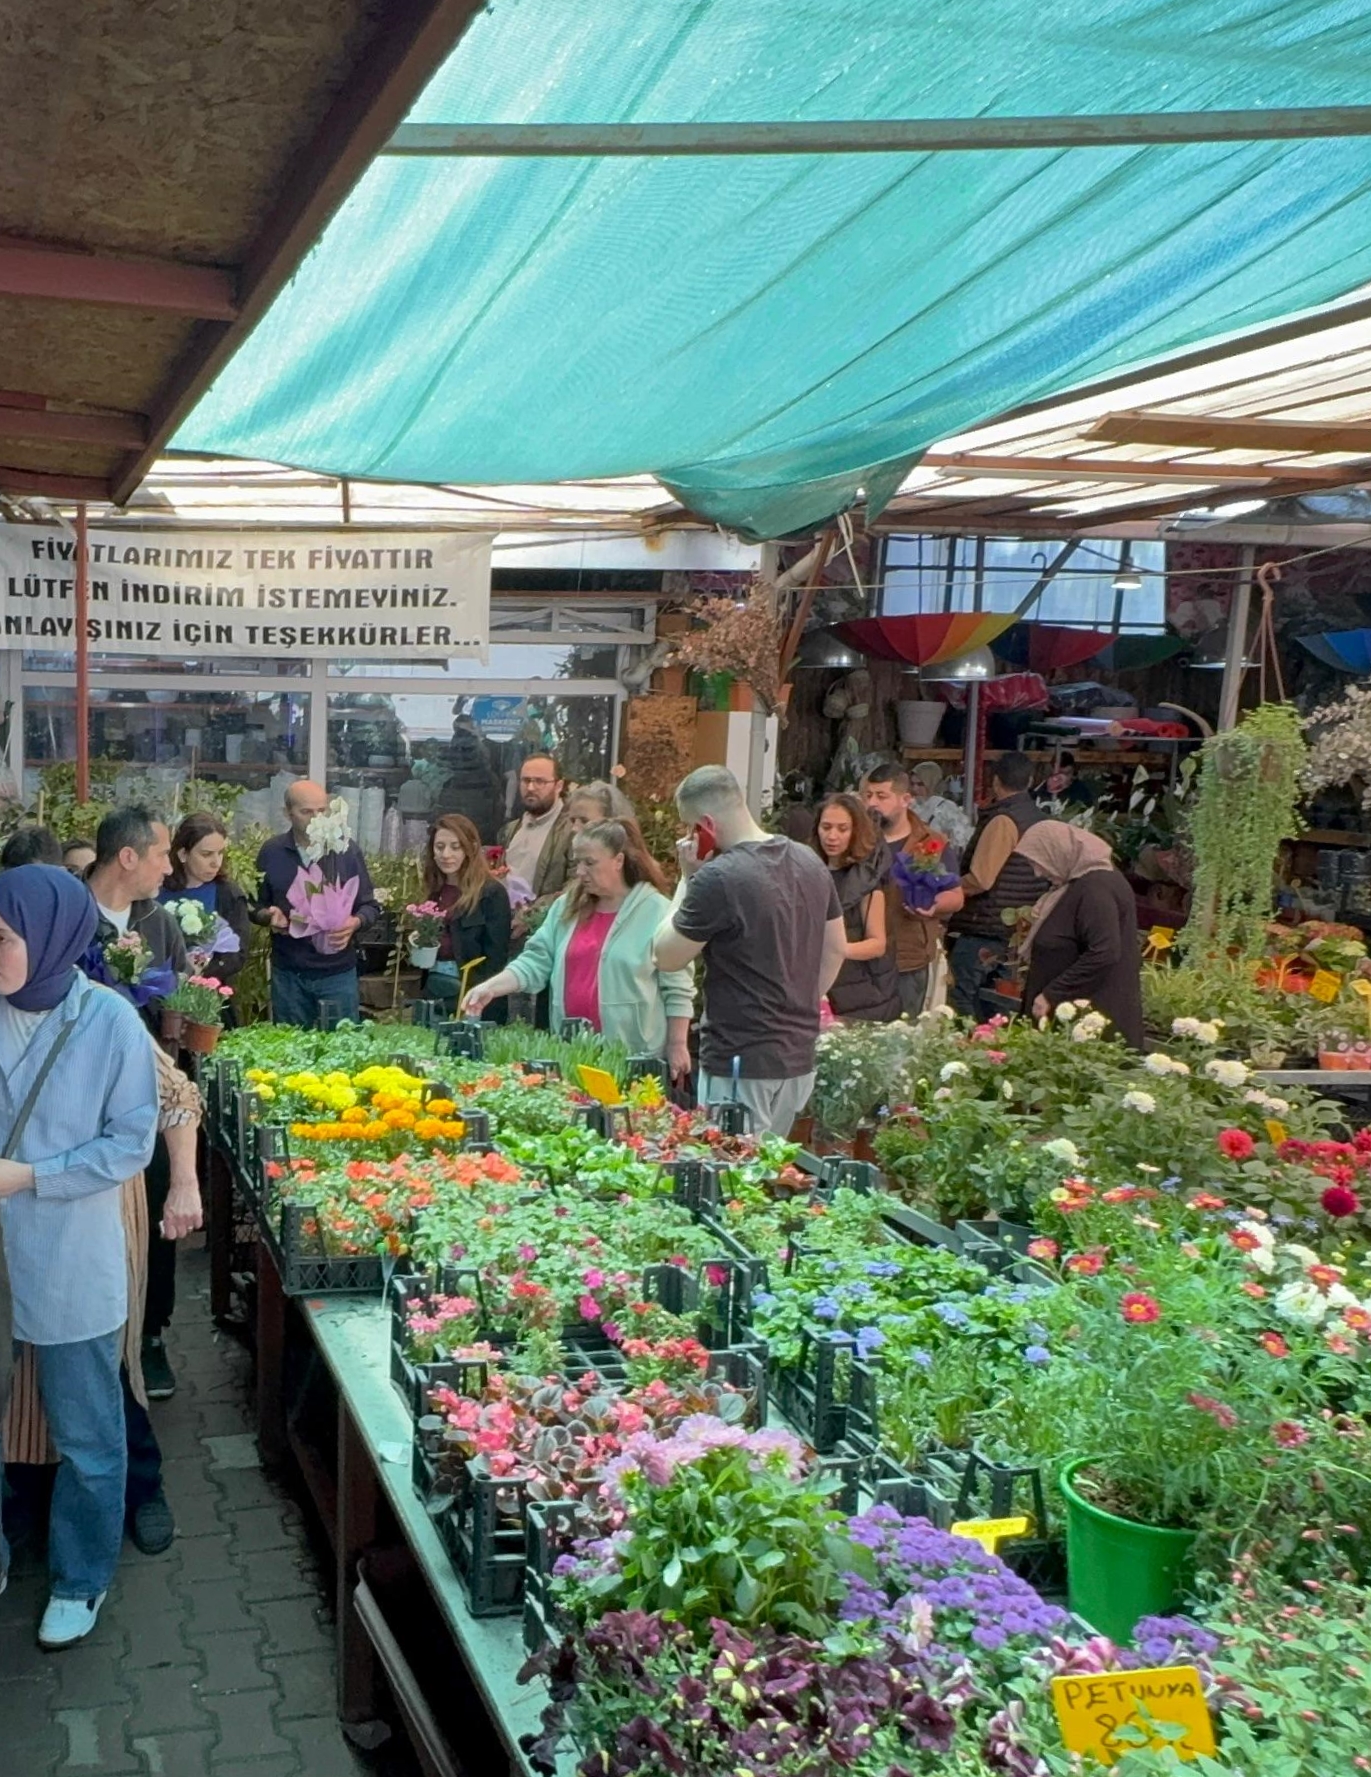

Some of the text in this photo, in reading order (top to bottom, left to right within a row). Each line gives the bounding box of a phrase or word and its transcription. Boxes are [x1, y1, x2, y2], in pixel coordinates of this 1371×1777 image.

[244, 549, 296, 569] TEK
[308, 545, 433, 569] FİYATTIR
[8, 573, 457, 608] LÜTFN İNDİRİM İSTEMEYİNİZ.
[173, 619, 233, 646] İÇİN
[245, 622, 480, 648] TEŞEKKÜRLER...
[1063, 1680, 1196, 1710] PETUNYA
